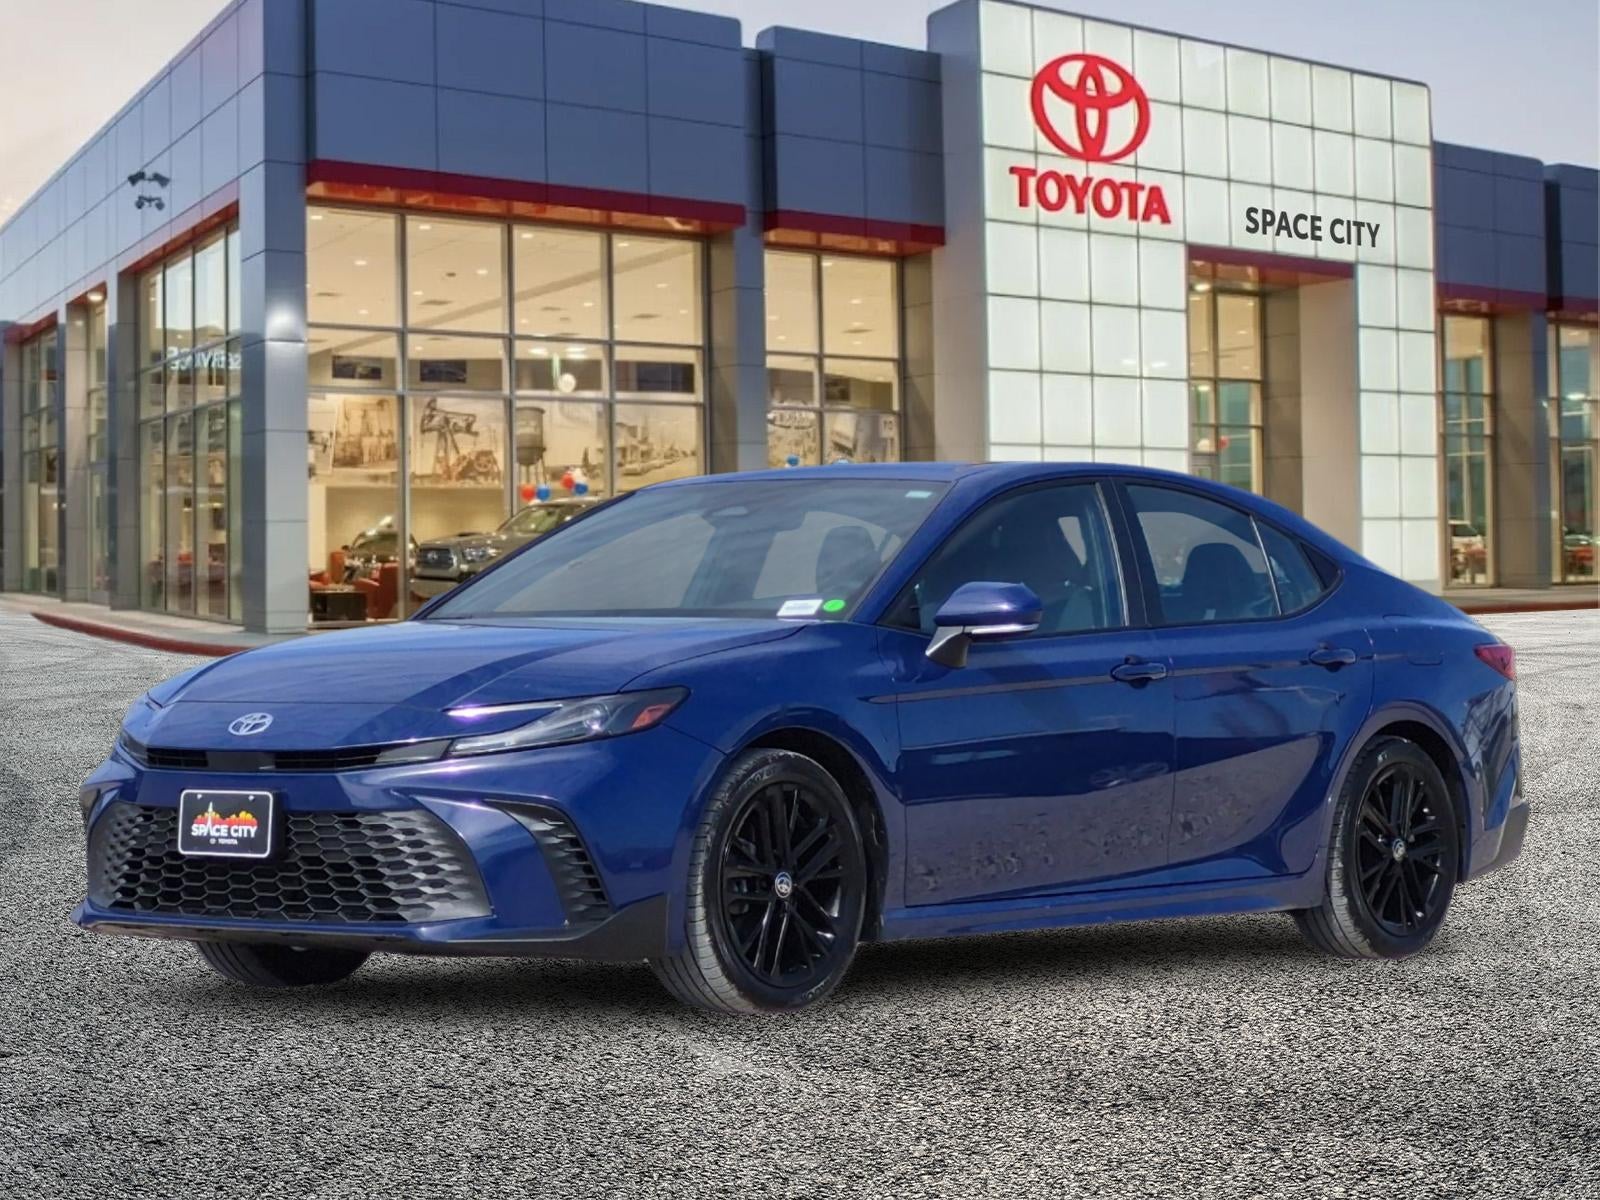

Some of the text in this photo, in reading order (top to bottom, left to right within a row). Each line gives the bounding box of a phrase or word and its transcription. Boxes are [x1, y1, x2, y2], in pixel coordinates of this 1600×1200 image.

[1008, 166, 1172, 225] TOYOTA
[1245, 206, 1381, 248] SPACE CITY
[191, 823, 258, 838] SPACE CITY
